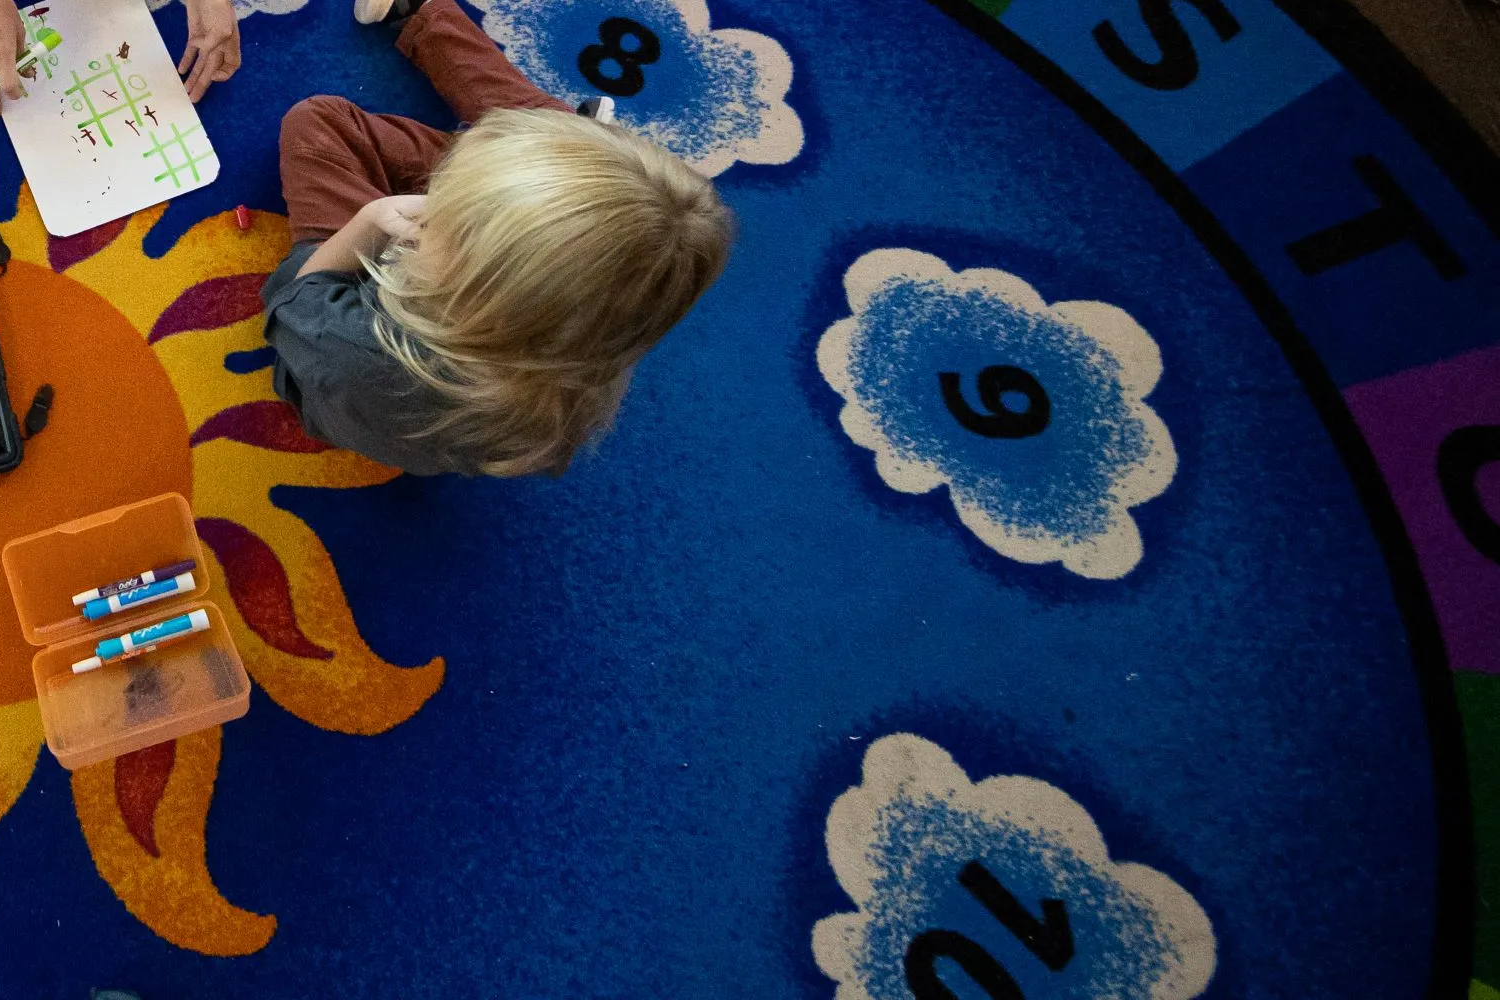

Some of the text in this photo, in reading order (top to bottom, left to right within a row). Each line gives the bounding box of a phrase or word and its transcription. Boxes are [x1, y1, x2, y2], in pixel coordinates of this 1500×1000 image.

[577, 16, 661, 96] 8
[1285, 153, 1467, 282] T
[937, 365, 1051, 439] 9
